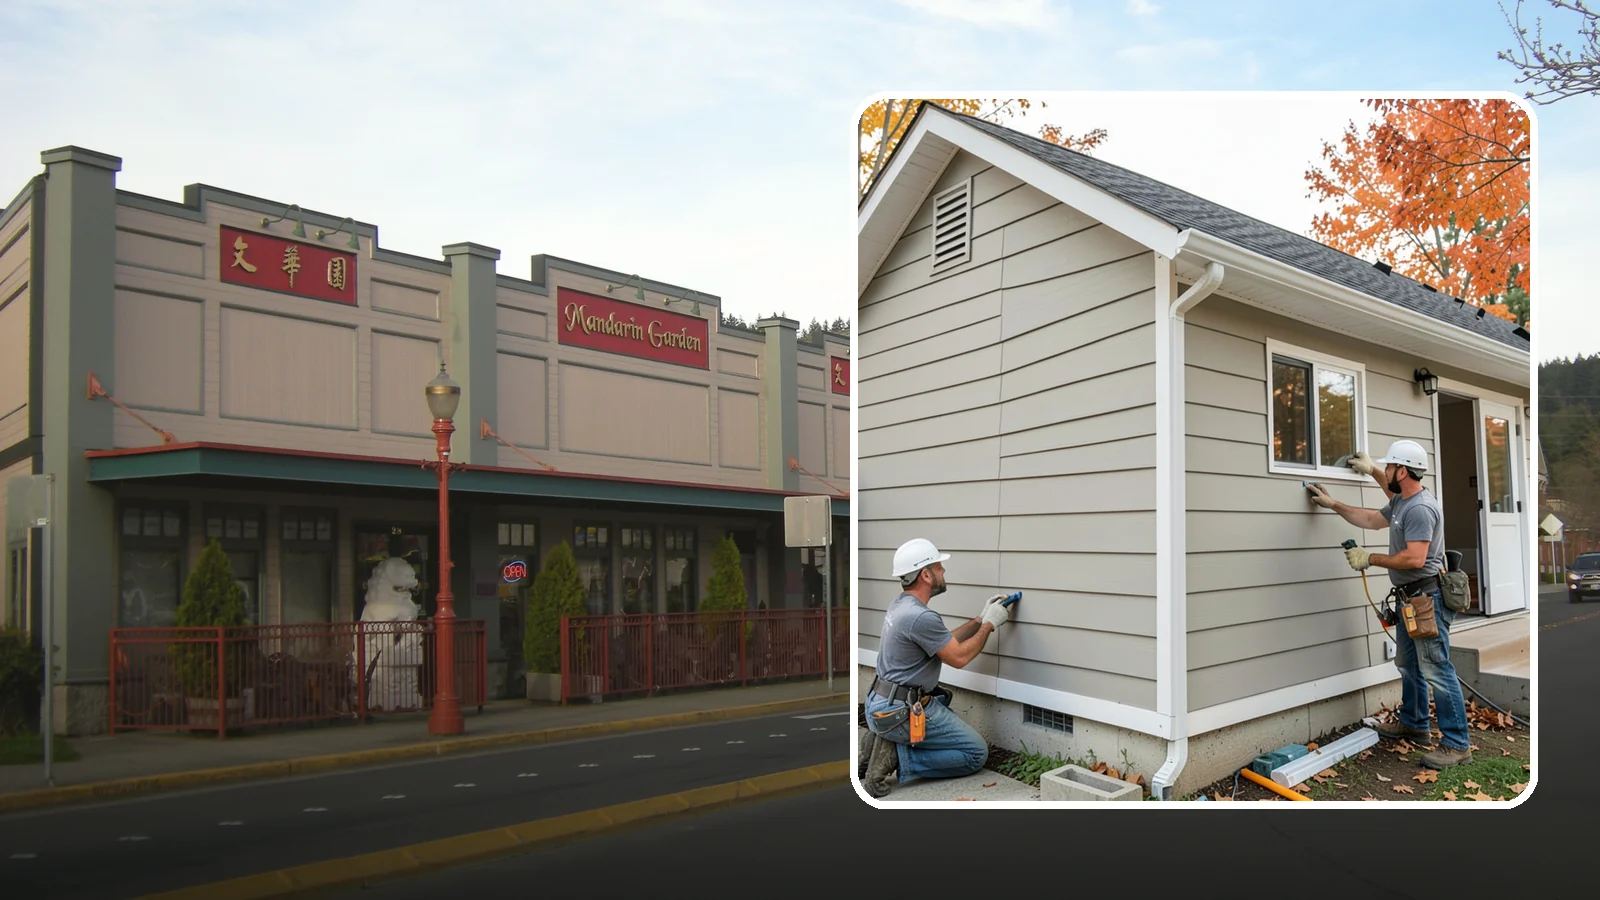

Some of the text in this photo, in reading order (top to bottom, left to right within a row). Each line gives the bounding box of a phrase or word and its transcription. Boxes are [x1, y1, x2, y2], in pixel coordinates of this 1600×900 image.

[564, 302, 701, 352] Mandarin Garden
[503, 565, 527, 578] OPEN
